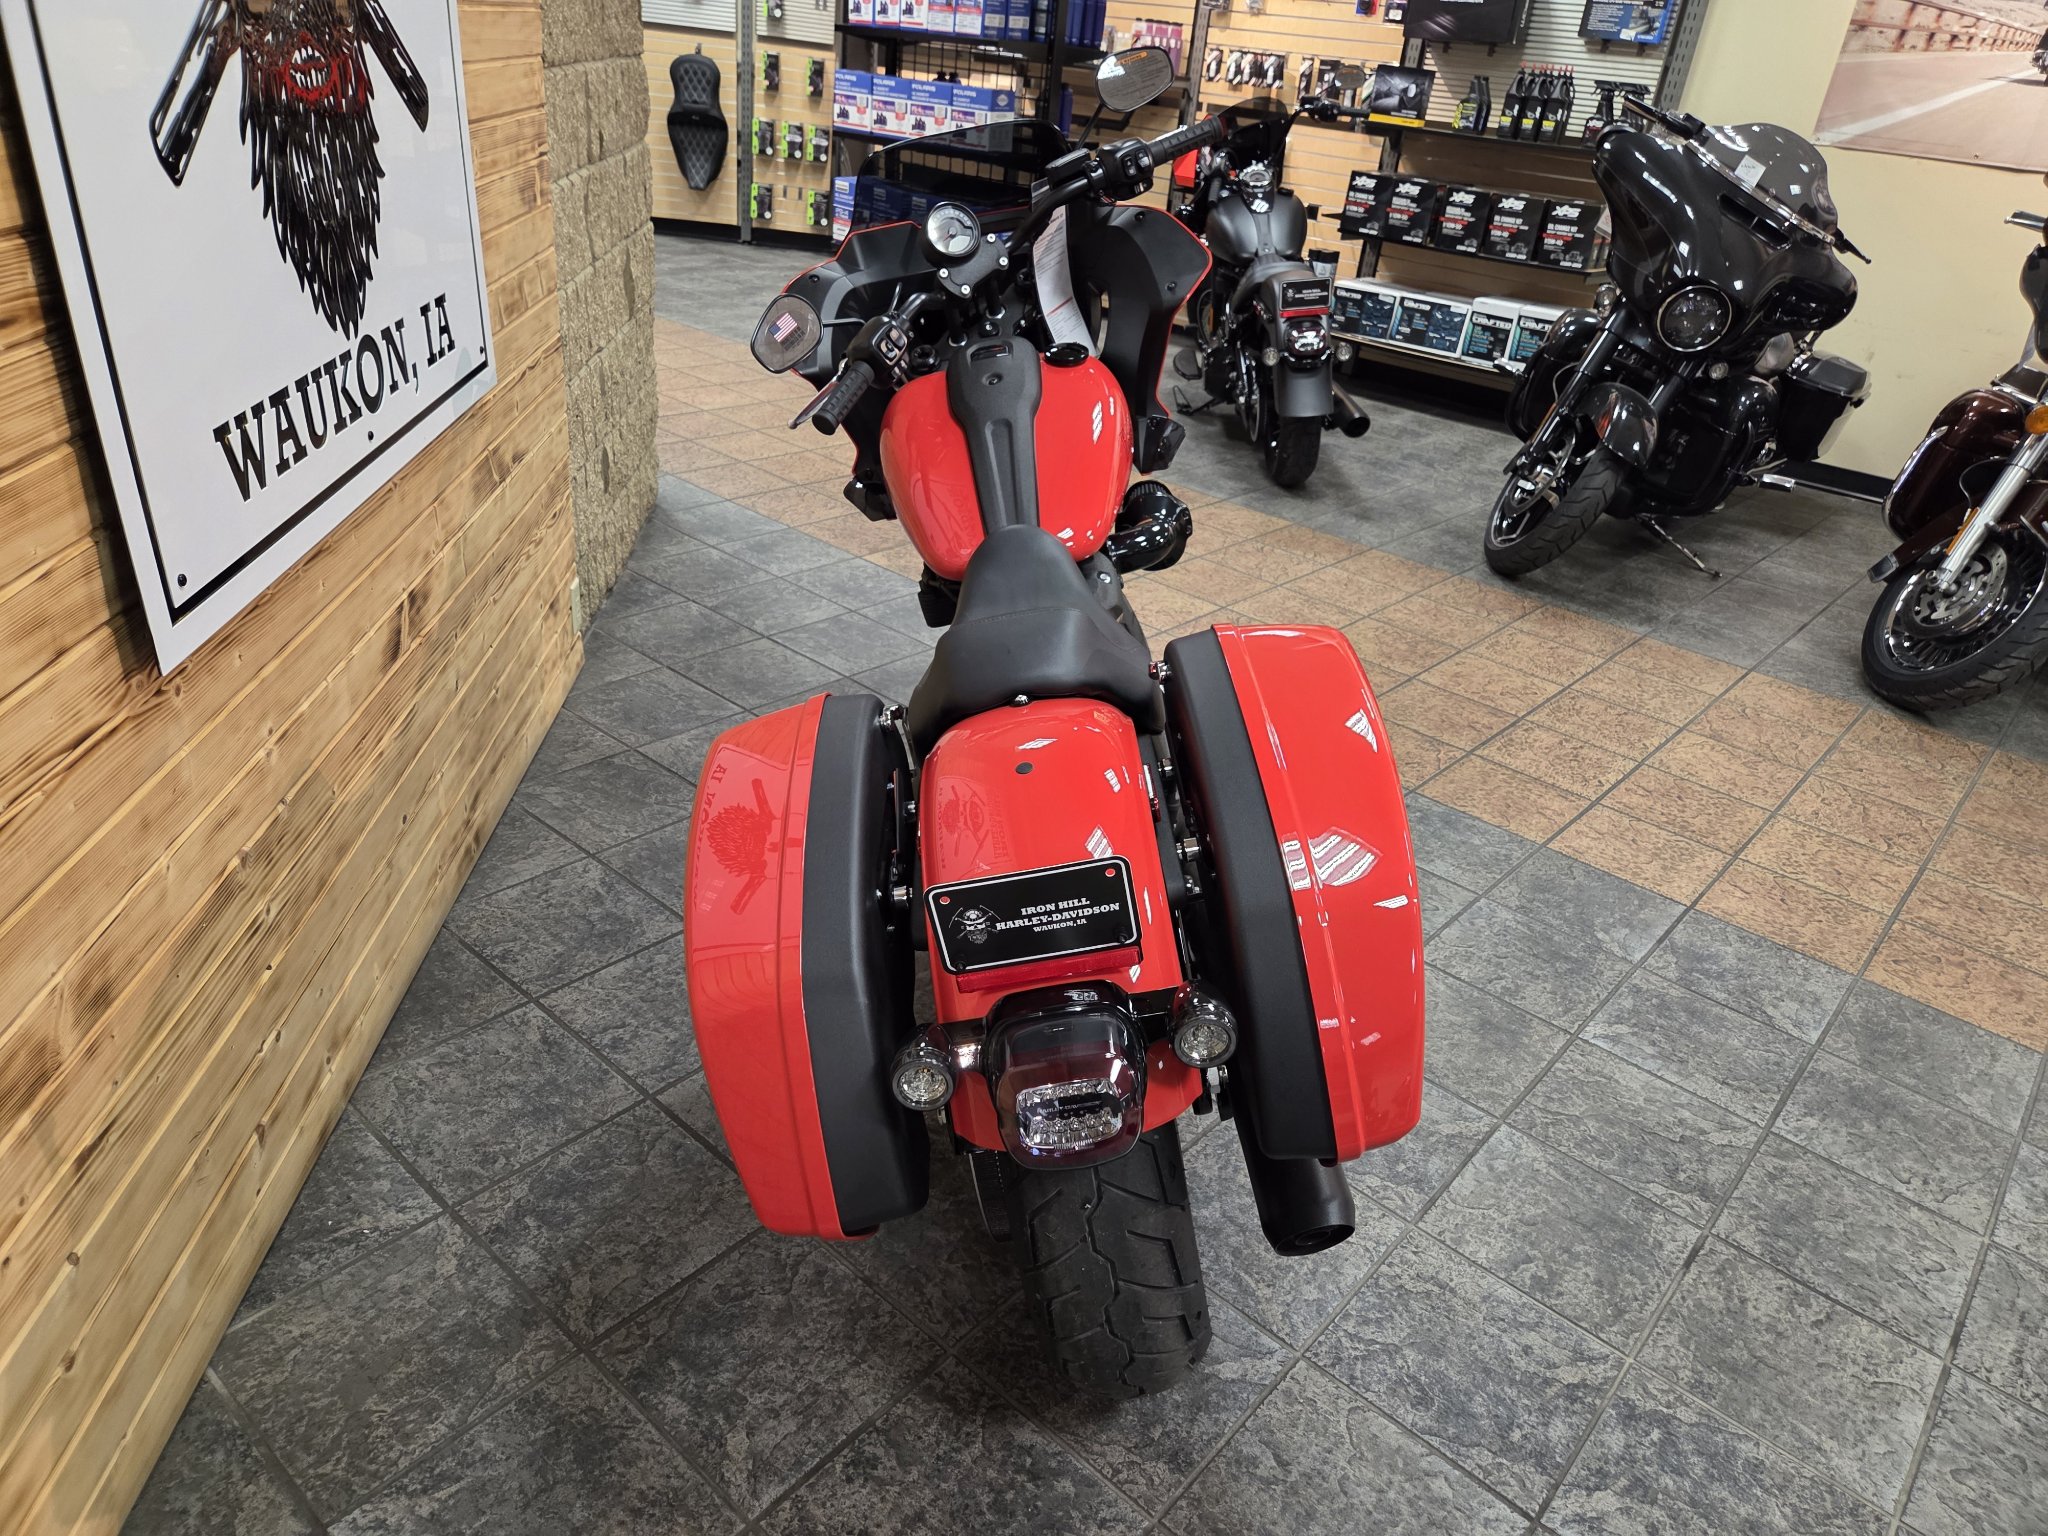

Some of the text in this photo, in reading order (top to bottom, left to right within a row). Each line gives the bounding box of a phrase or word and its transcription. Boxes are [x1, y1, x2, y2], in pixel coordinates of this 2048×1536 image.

[1352, 176, 1378, 188] XPS
[1395, 182, 1422, 195] XPS
[1449, 191, 1476, 204] XPS
[1498, 197, 1527, 210] XPS
[1552, 204, 1582, 218] XPS
[1472, 316, 1512, 331] CRAFTED
[212, 292, 456, 503] WAUKON, IA
[1021, 897, 1090, 916] IRON HILL
[995, 902, 1120, 931] HARLEY-DAVIDSON
